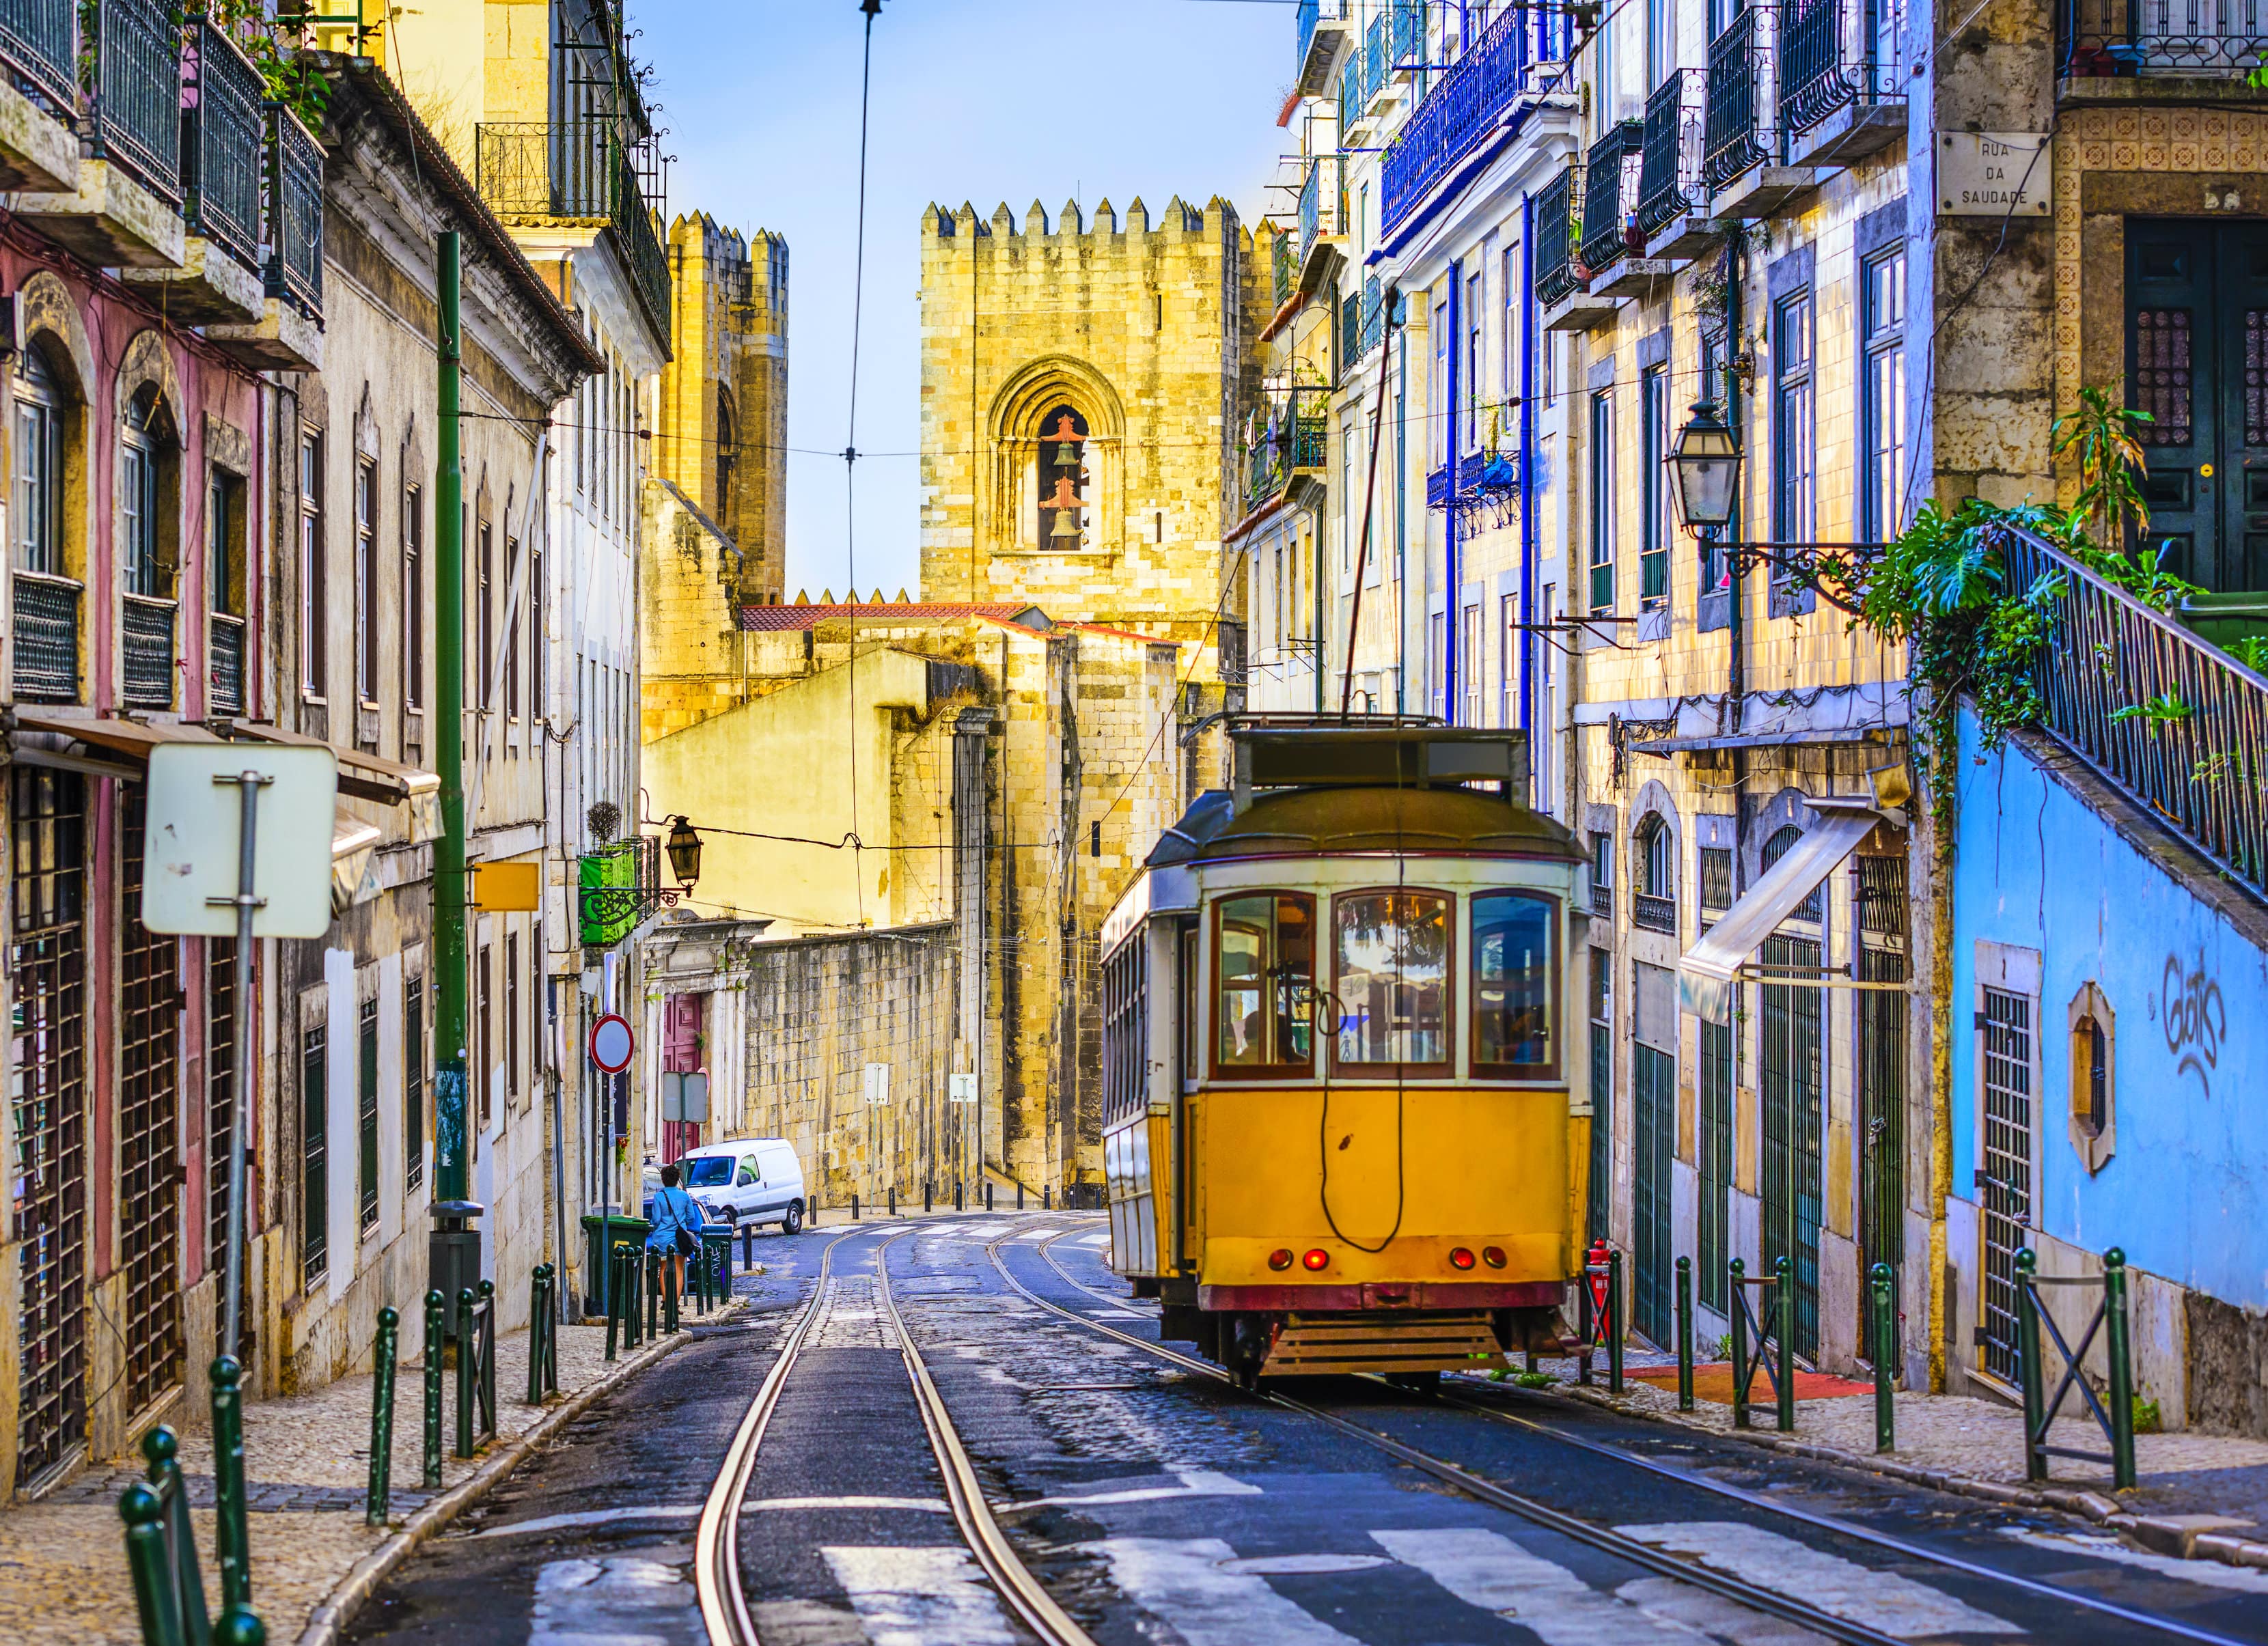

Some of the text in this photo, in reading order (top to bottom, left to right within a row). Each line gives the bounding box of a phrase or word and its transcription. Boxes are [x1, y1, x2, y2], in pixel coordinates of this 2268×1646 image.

[1982, 143, 2009, 156] RUA
[1987, 167, 2004, 180] DA
[1962, 191, 2028, 204] SAUDADE
